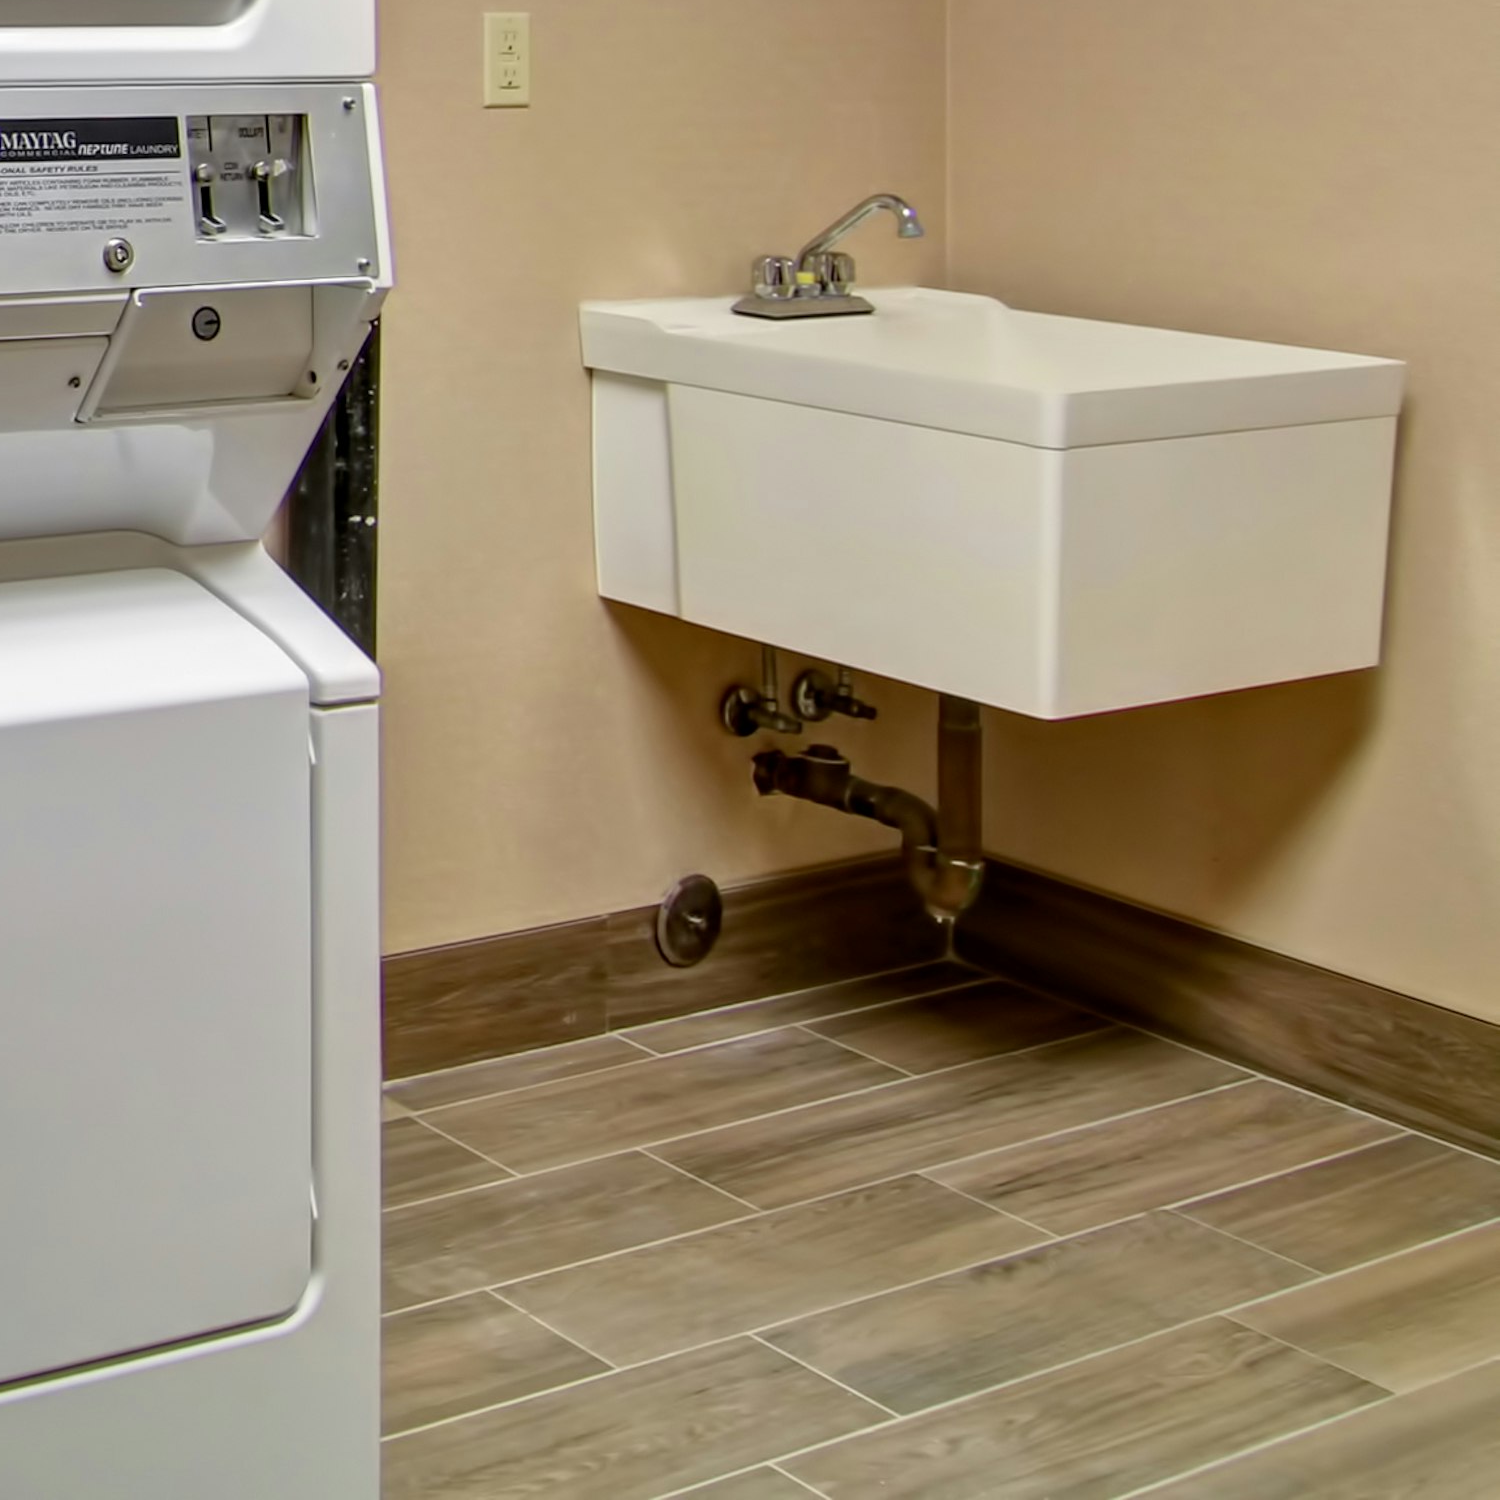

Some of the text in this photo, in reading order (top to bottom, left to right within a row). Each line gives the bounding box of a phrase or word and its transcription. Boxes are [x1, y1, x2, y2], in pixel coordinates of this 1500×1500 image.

[0, 131, 77, 150] MAYTAG
[0, 150, 77, 158] COMMERCIAL
[130, 145, 178, 154] LAUNDRY
